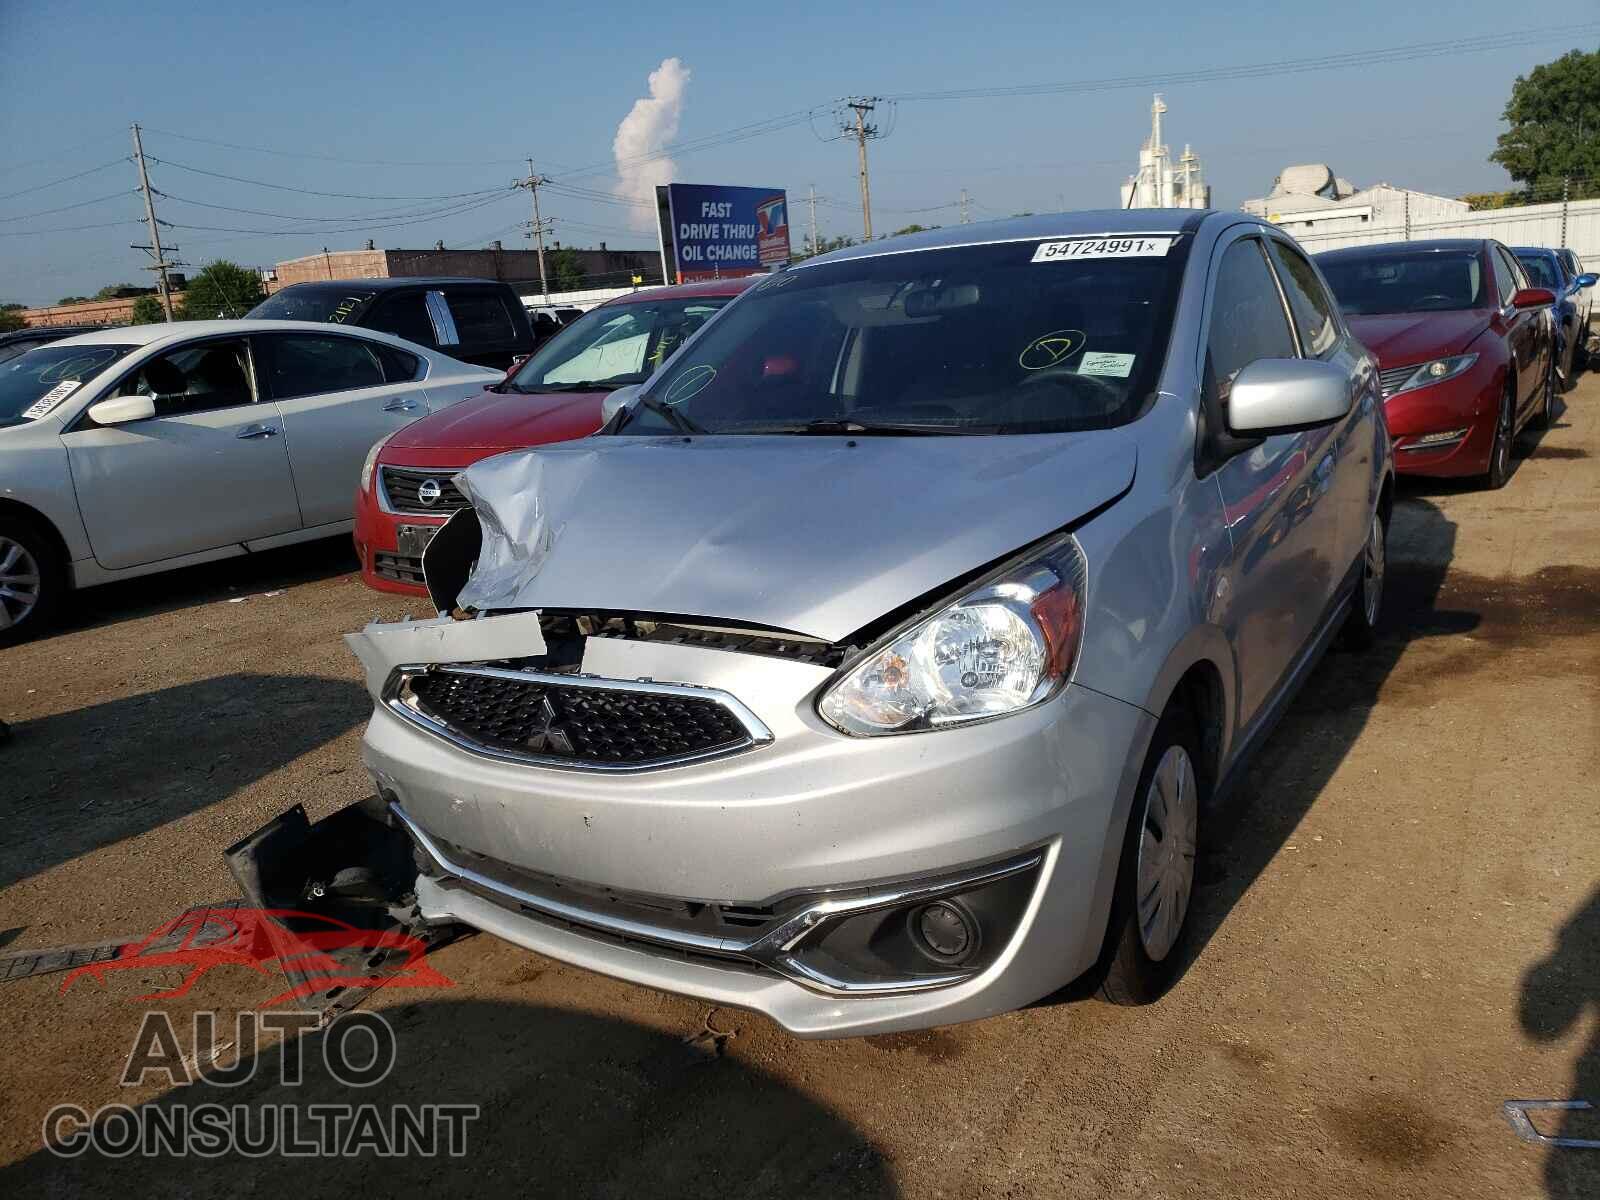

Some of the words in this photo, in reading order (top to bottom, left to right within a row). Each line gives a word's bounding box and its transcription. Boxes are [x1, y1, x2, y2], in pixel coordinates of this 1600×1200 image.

[702, 202, 732, 218] FAST
[680, 224, 720, 239] DRIVE
[723, 223, 755, 239] THRU
[682, 245, 704, 261] OIL
[706, 245, 757, 260] CHANGE
